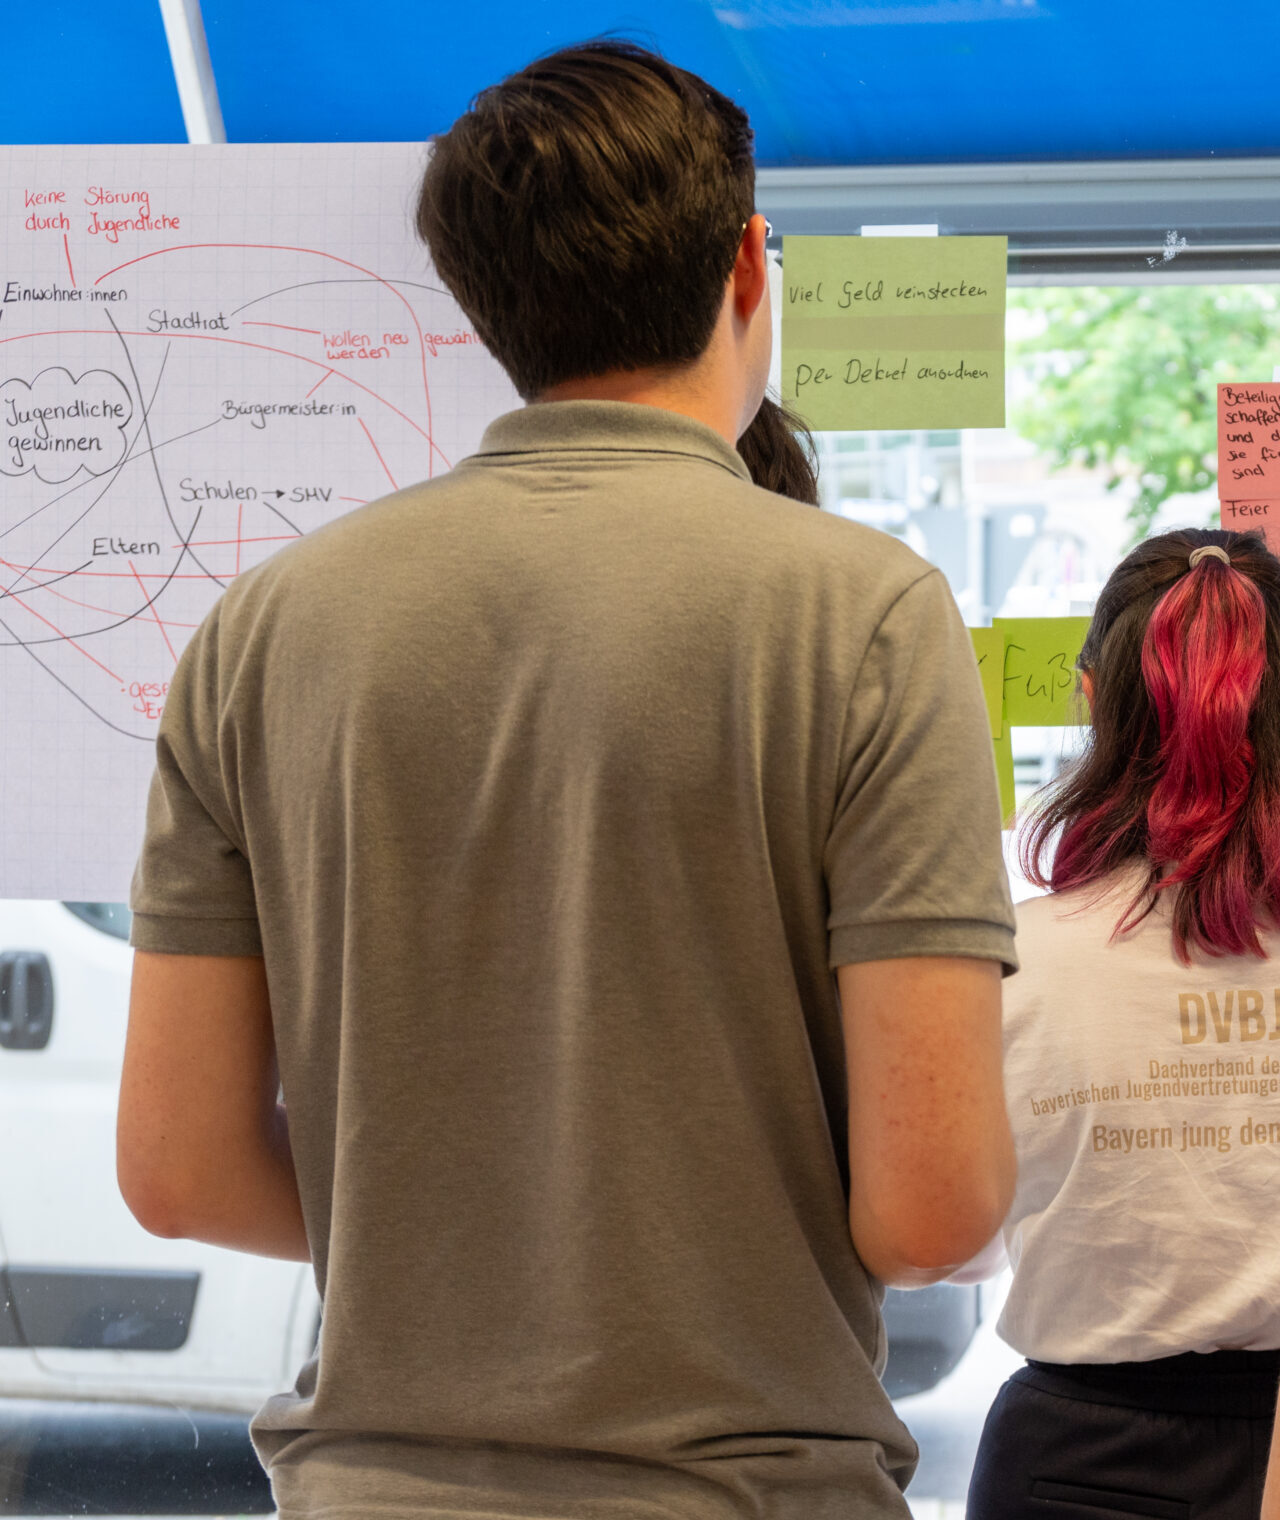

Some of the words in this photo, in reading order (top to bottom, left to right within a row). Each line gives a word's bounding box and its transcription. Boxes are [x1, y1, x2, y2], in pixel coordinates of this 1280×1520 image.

[84, 186, 151, 217] Störung
[25, 212, 70, 231] durch
[87, 212, 181, 244] Jugendliche
[838, 280, 884, 308] Geld
[147, 309, 230, 333] Stadtrat
[327, 347, 390, 360] werden
[383, 333, 409, 345] neu
[424, 328, 485, 357] gewähl
[5, 398, 125, 440] Jugendliche
[8, 433, 103, 468] gewinnen
[1226, 431, 1255, 444] und
[180, 477, 257, 503] Schulen
[92, 536, 161, 557] Eltern
[1149, 1056, 1255, 1080] Dachverband
[1030, 1083, 1121, 1117] bayerischen
[1092, 1124, 1174, 1153] Bayern
[1180, 1120, 1233, 1153] jung
